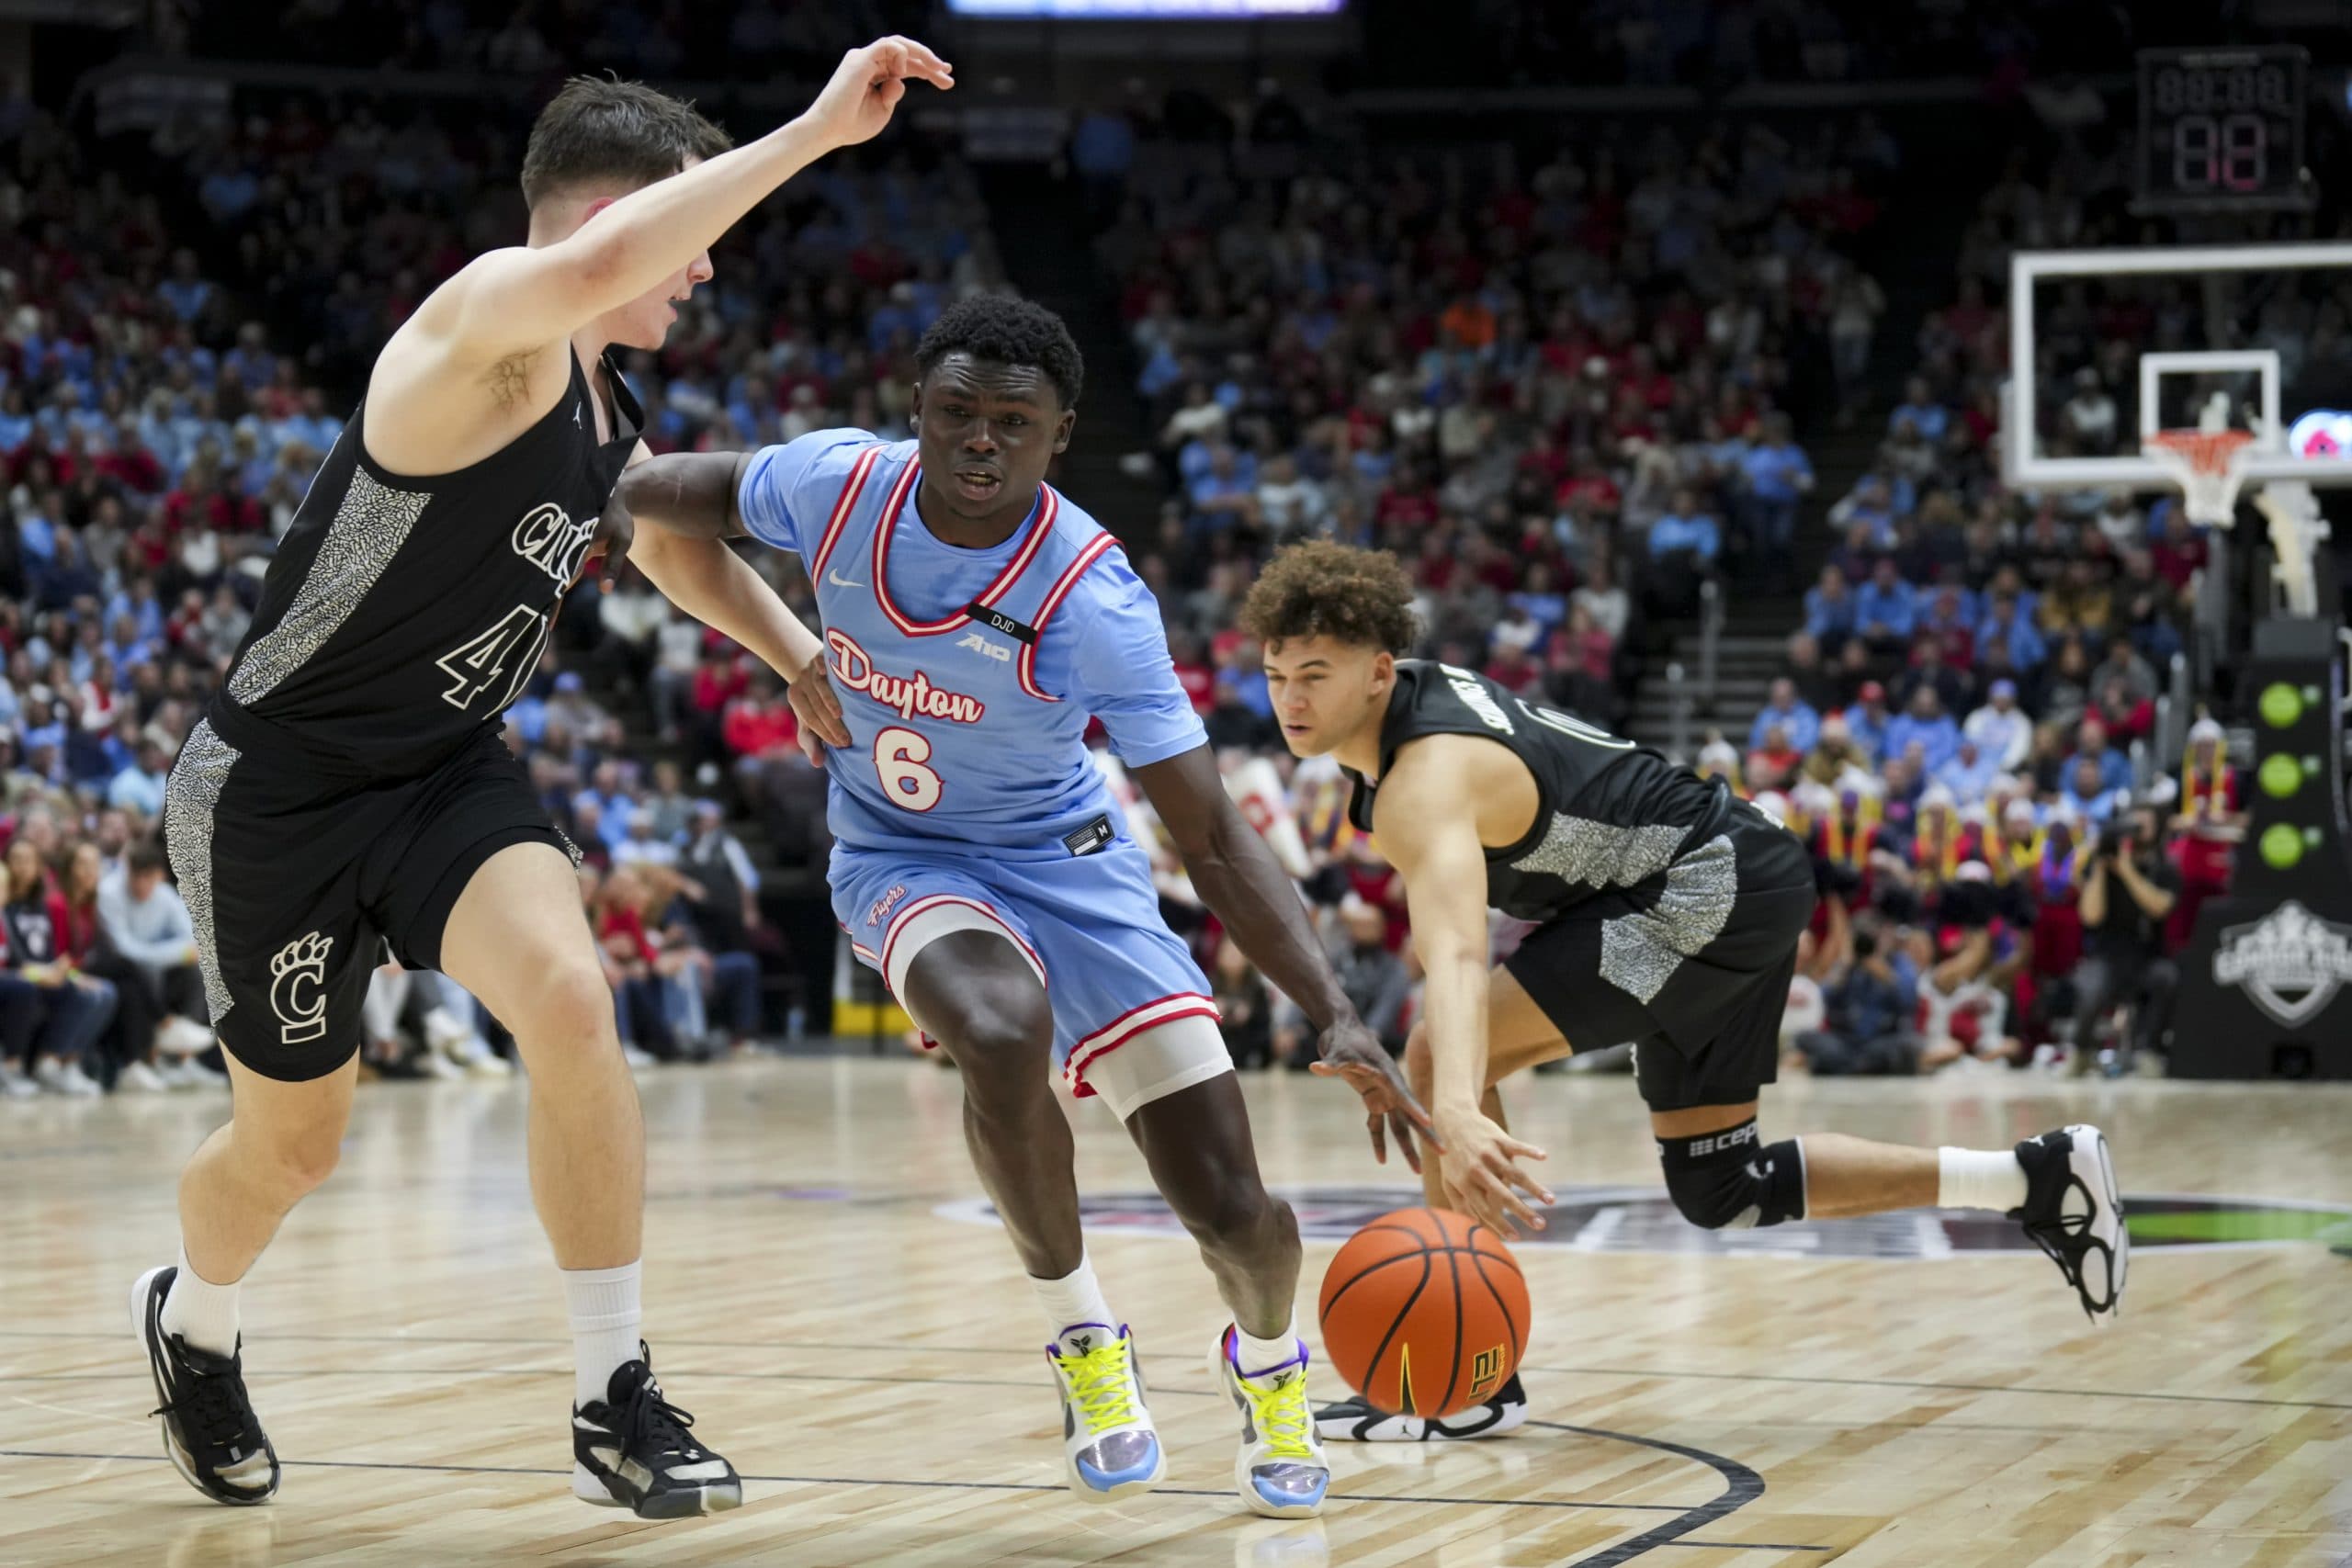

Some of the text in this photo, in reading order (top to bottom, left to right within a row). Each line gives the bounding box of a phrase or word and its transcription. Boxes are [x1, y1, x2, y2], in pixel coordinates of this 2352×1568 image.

[990, 614, 1015, 634] DJD
[956, 632, 1011, 662] A10
[827, 626, 985, 724] Dayton
[874, 726, 943, 813] 6
[1097, 824, 1109, 837] M
[866, 885, 907, 927] Flyers
